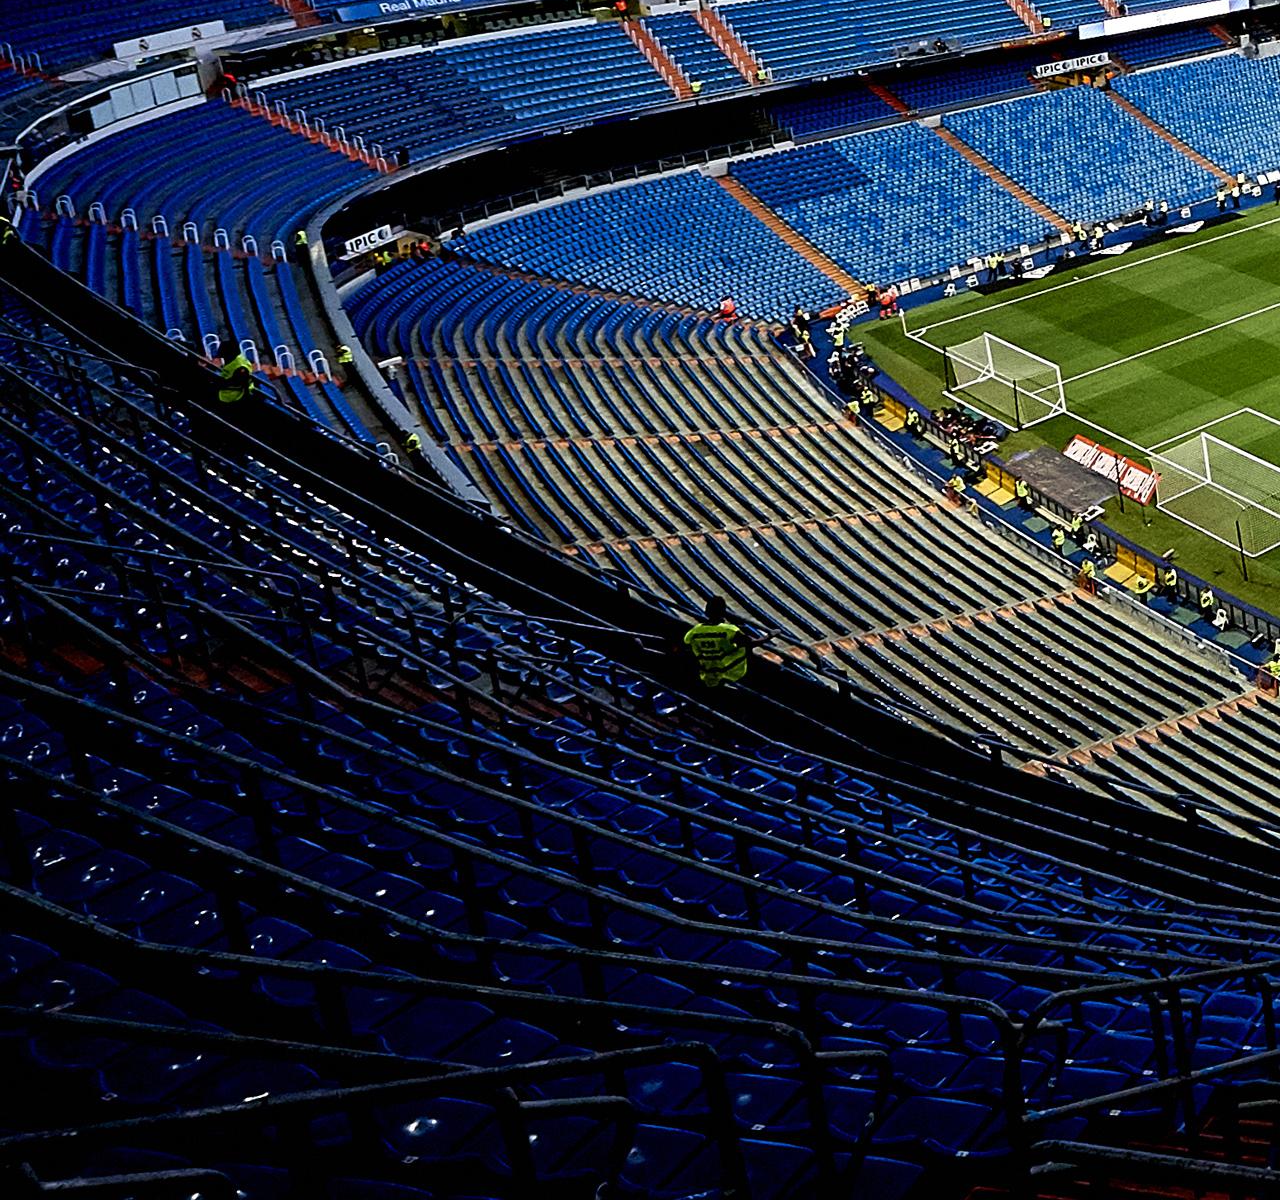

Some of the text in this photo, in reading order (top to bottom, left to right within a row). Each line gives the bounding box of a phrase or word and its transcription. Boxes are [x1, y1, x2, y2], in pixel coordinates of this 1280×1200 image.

[380, 0, 410, 13] Real
[1040, 56, 1096, 74] IPIC IPIC
[349, 232, 375, 253] IPIC
